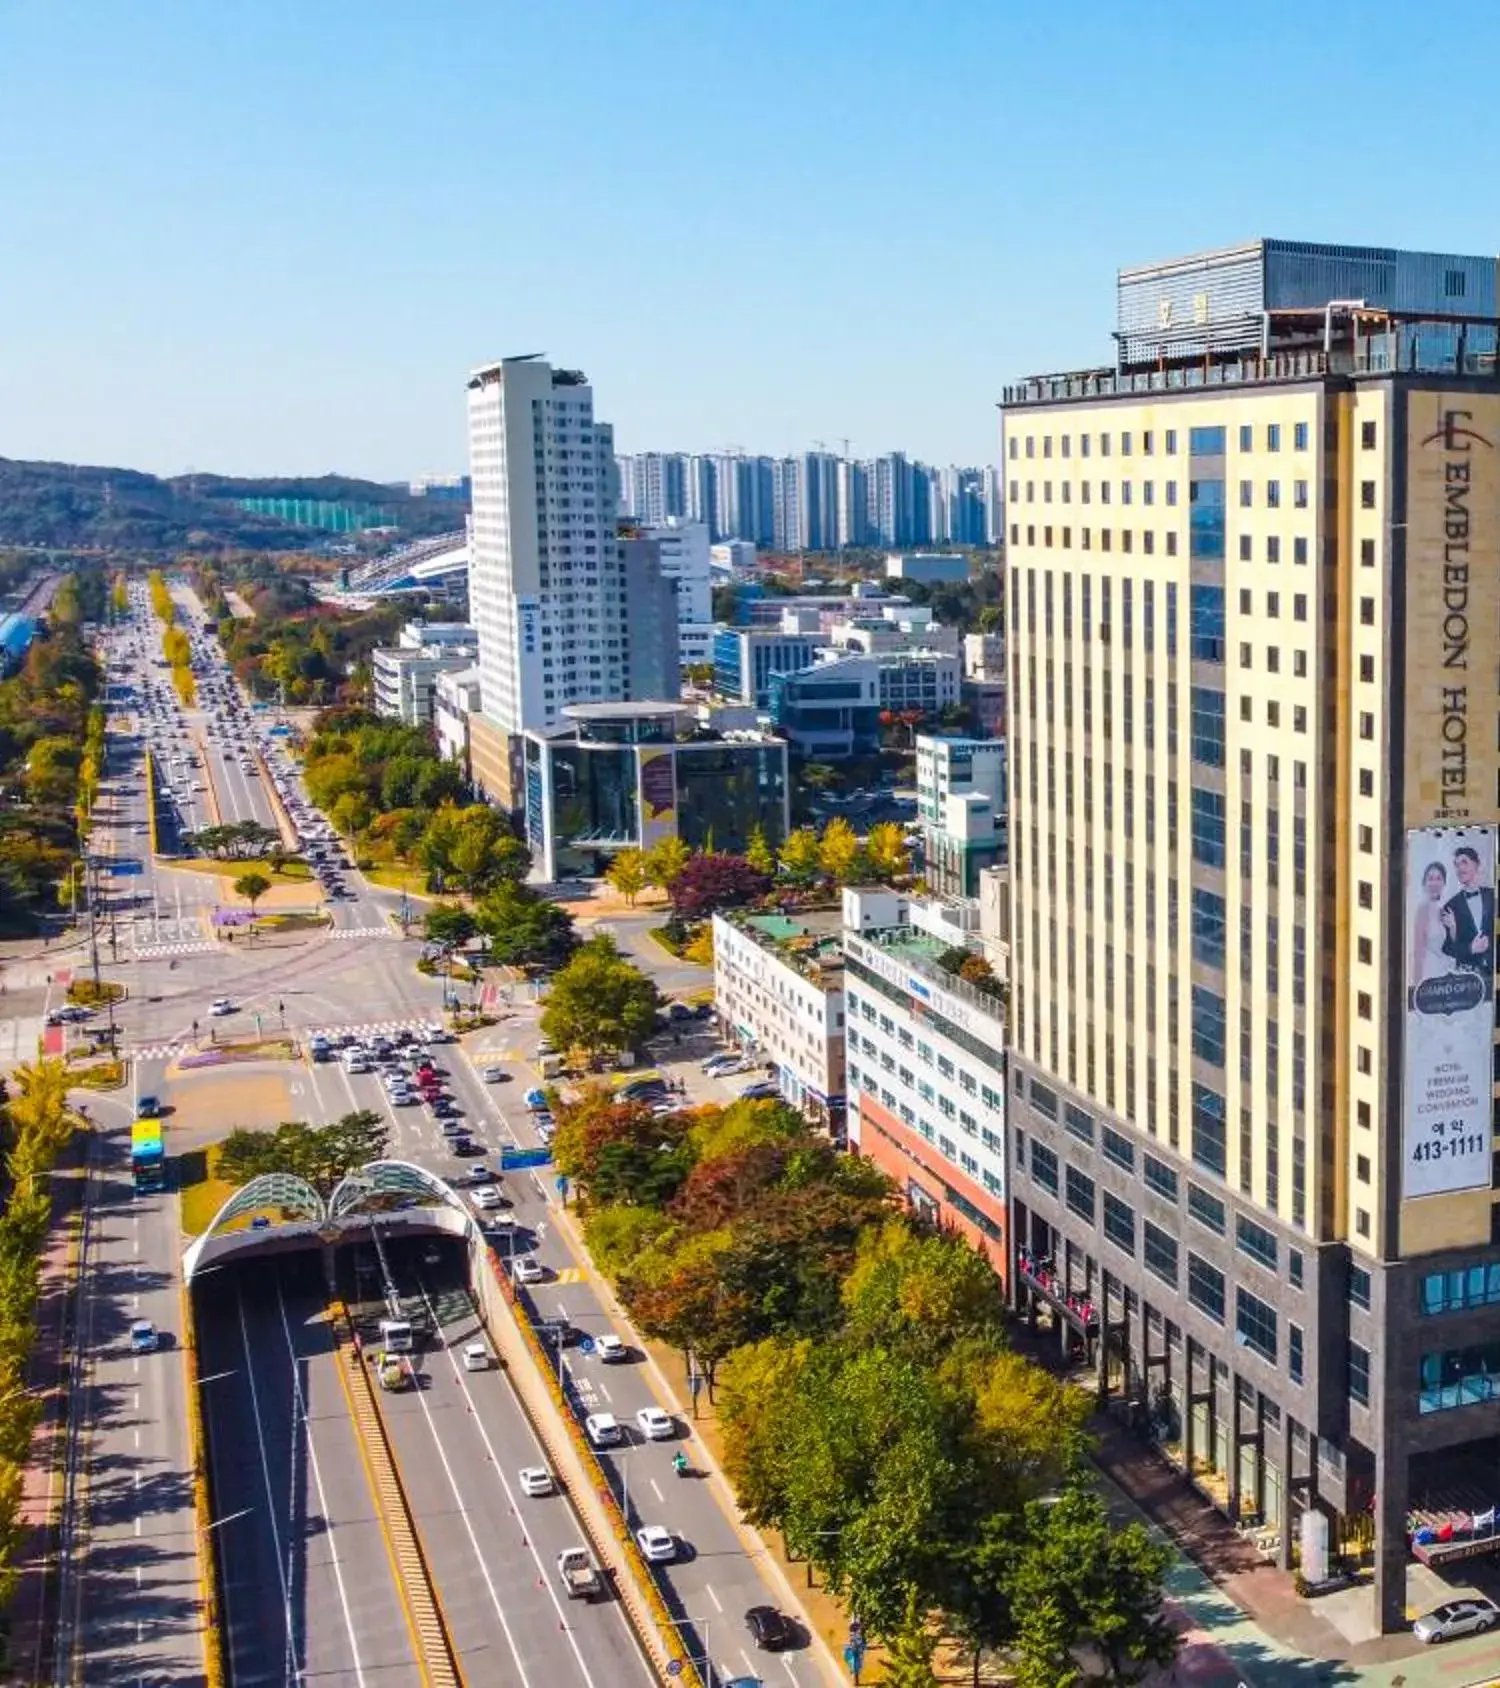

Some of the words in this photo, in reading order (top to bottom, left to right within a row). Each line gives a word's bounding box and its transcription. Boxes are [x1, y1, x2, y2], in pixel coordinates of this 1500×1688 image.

[1441, 461, 1471, 670] EMBLEDON
[1441, 687, 1467, 808] HOTEL
[1413, 1133, 1483, 1161] 413-1111
